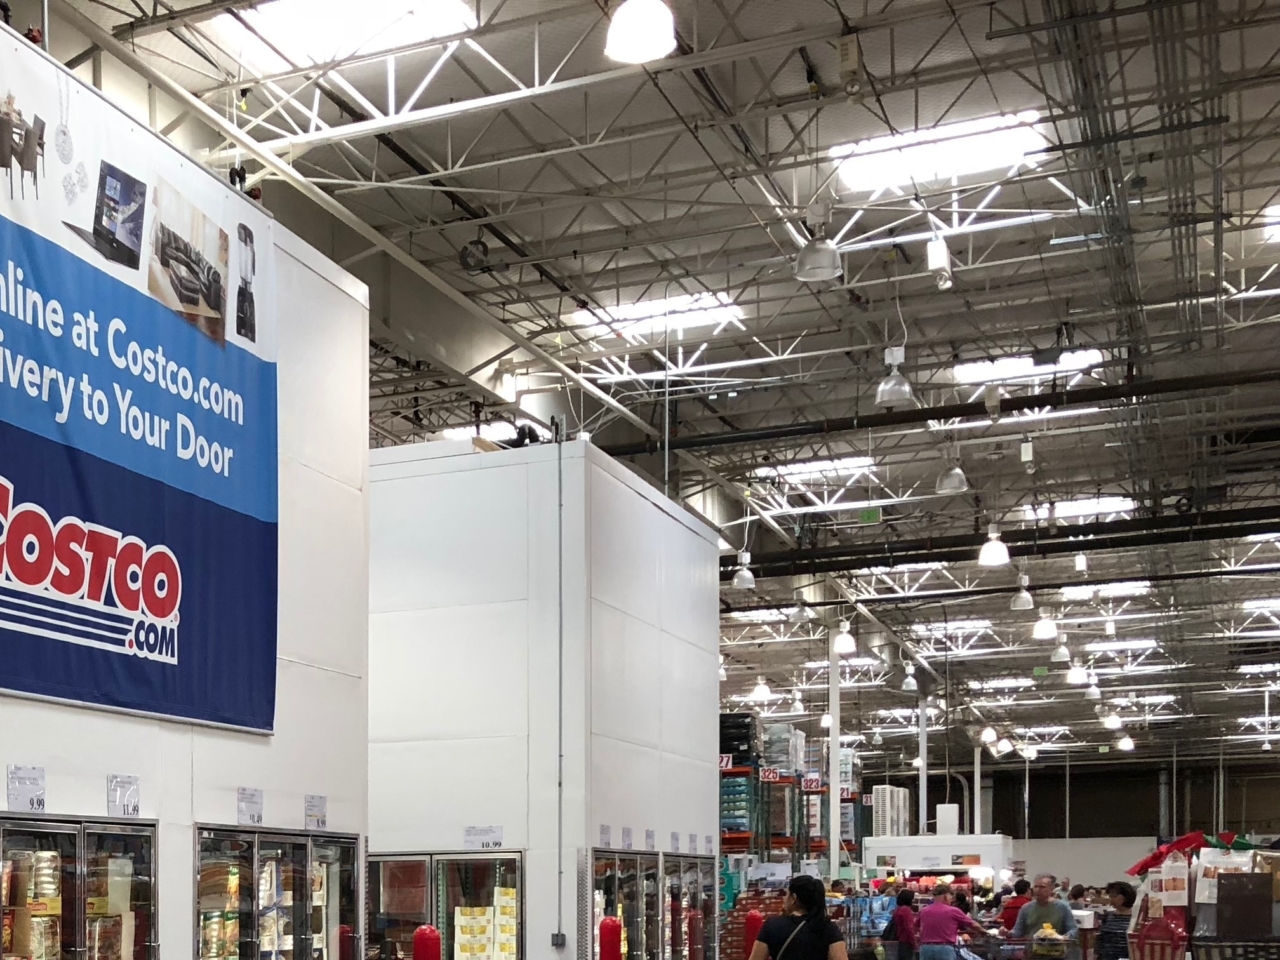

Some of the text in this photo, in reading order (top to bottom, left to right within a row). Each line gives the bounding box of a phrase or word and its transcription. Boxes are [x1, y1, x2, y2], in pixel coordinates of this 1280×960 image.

[71, 310, 99, 357] at
[106, 317, 244, 426] Costco.com
[80, 372, 109, 426] to
[113, 382, 170, 451] Your
[176, 413, 234, 478] Door
[760, 768, 778, 780] 325
[803, 778, 820, 790] 323
[29, 797, 45, 811] 9.99
[122, 804, 140, 816] 11.99
[481, 840, 502, 849] 10.99
